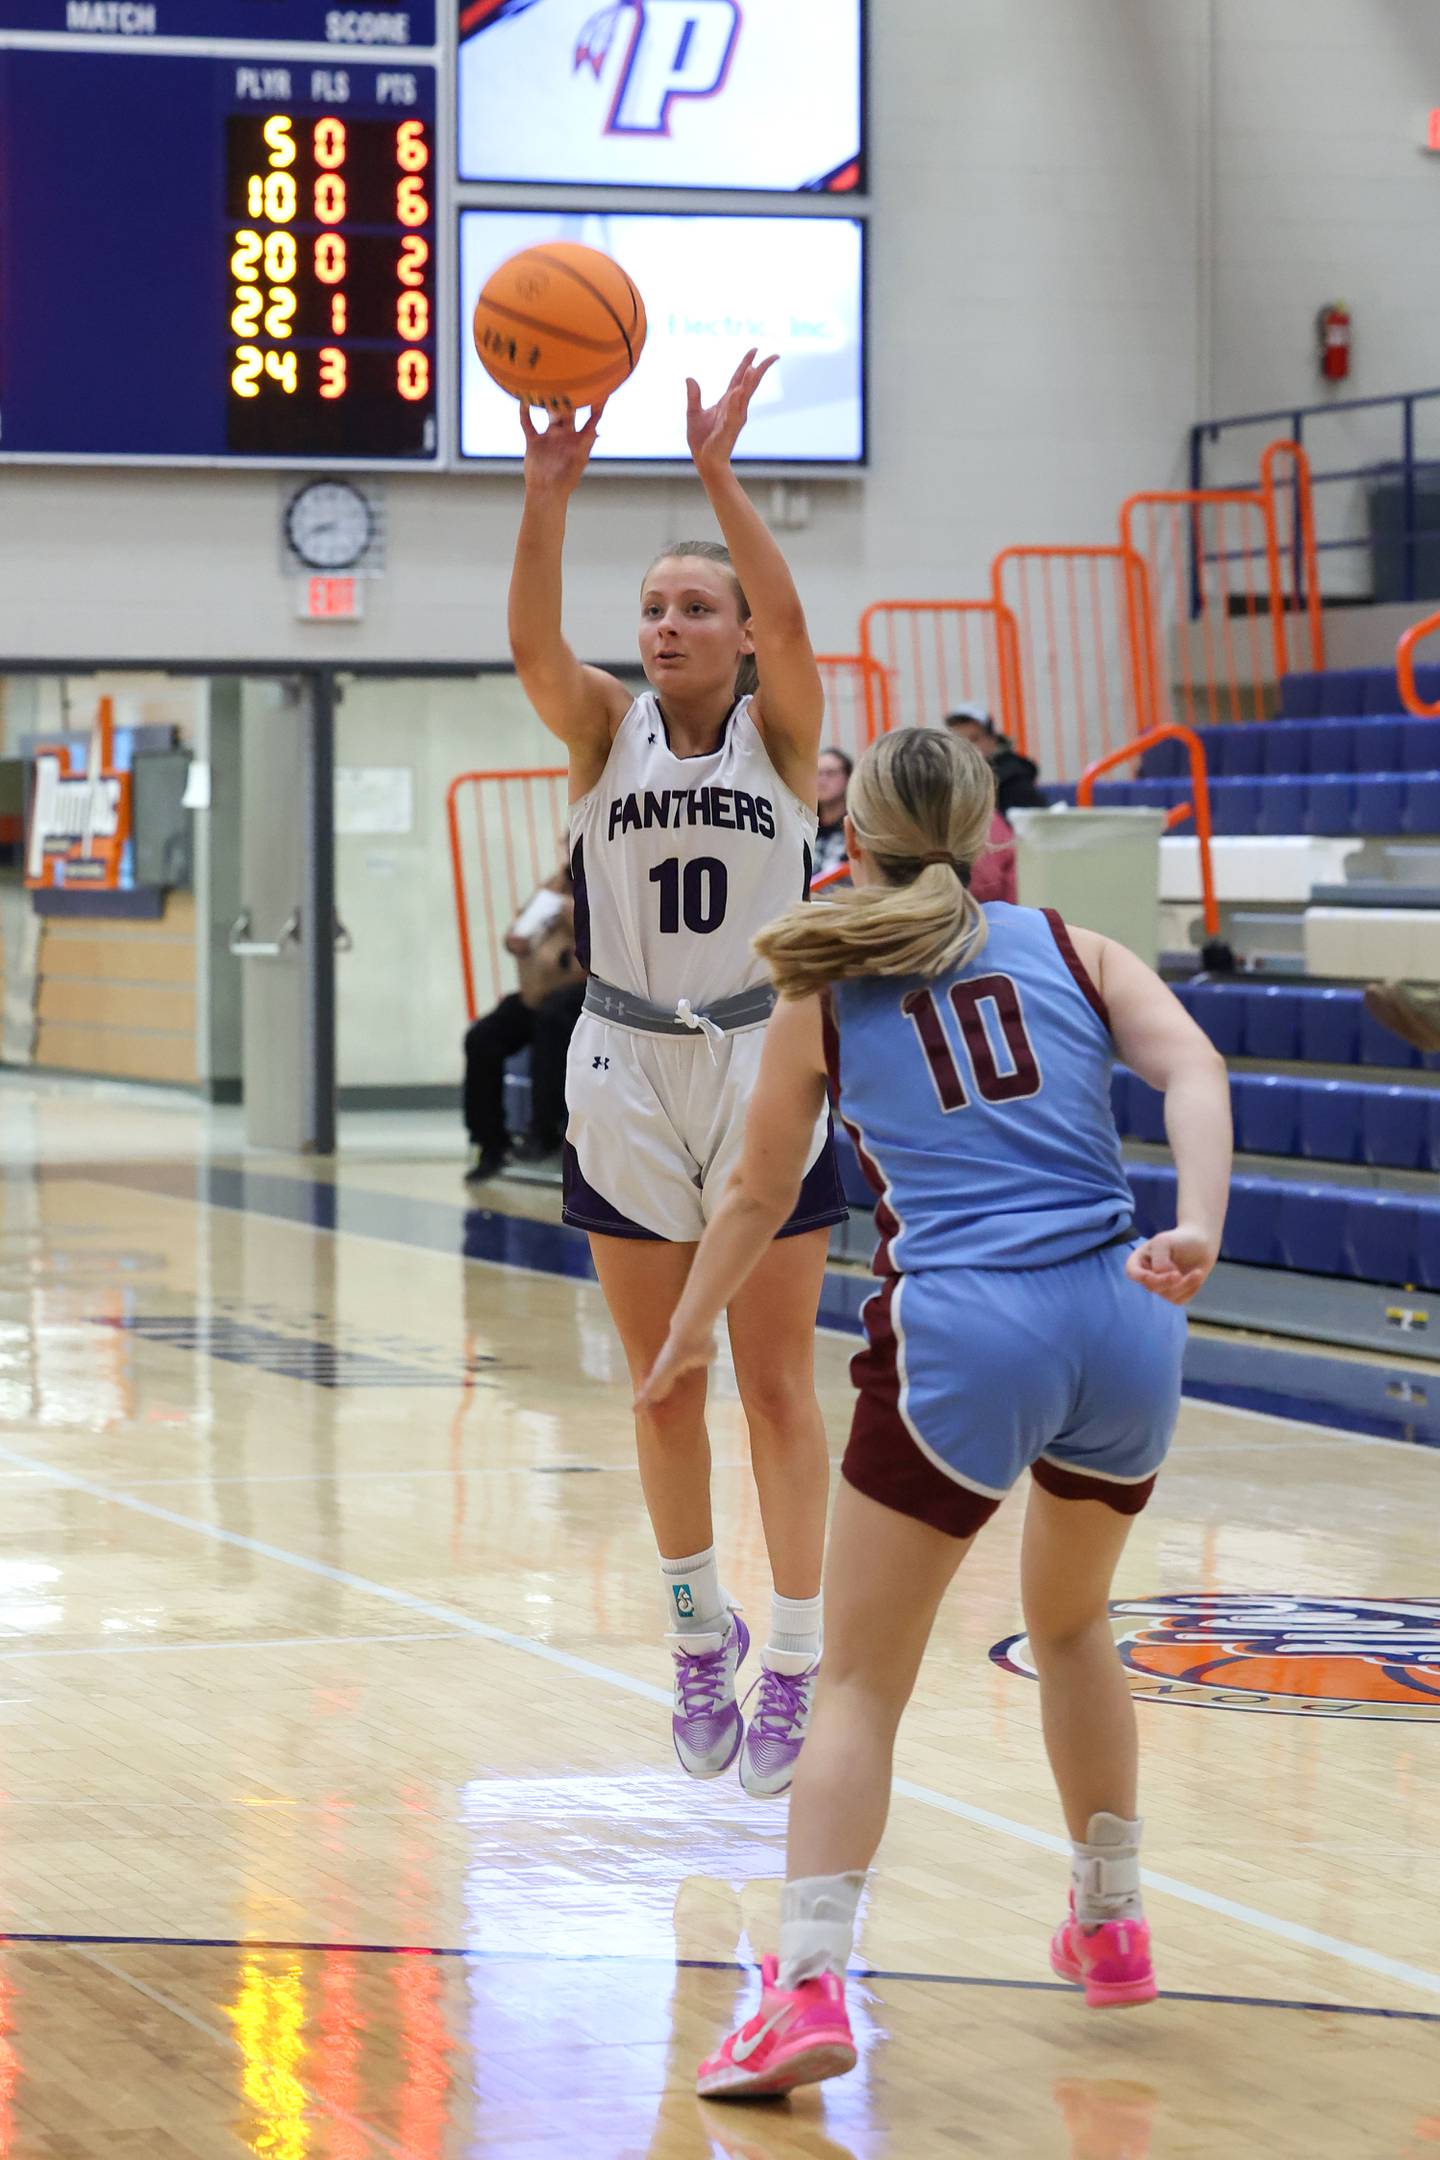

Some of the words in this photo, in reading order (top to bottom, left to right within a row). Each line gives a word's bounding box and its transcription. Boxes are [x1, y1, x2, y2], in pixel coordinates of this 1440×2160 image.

[66, 1, 156, 34] MATCH
[325, 11, 410, 44] SCORE
[235, 67, 292, 101] PLYR
[311, 70, 349, 103] FLS
[376, 73, 417, 105] PTS
[264, 115, 297, 168] 5
[313, 117, 346, 169] 0
[396, 120, 428, 172] 6
[248, 171, 297, 224] 10
[313, 173, 346, 225] 0
[396, 176, 428, 227] 6
[231, 229, 297, 283] 20
[313, 232, 346, 284] 0
[396, 235, 428, 286] 2
[231, 285, 297, 339] 22
[331, 292, 346, 335] 1
[396, 290, 428, 342] 0
[231, 345, 297, 397] 24
[318, 347, 346, 398] 3
[396, 350, 428, 401] 0
[608, 786, 775, 842] PANTHERS
[649, 856, 727, 934] 10
[901, 972, 1043, 1115] 10
